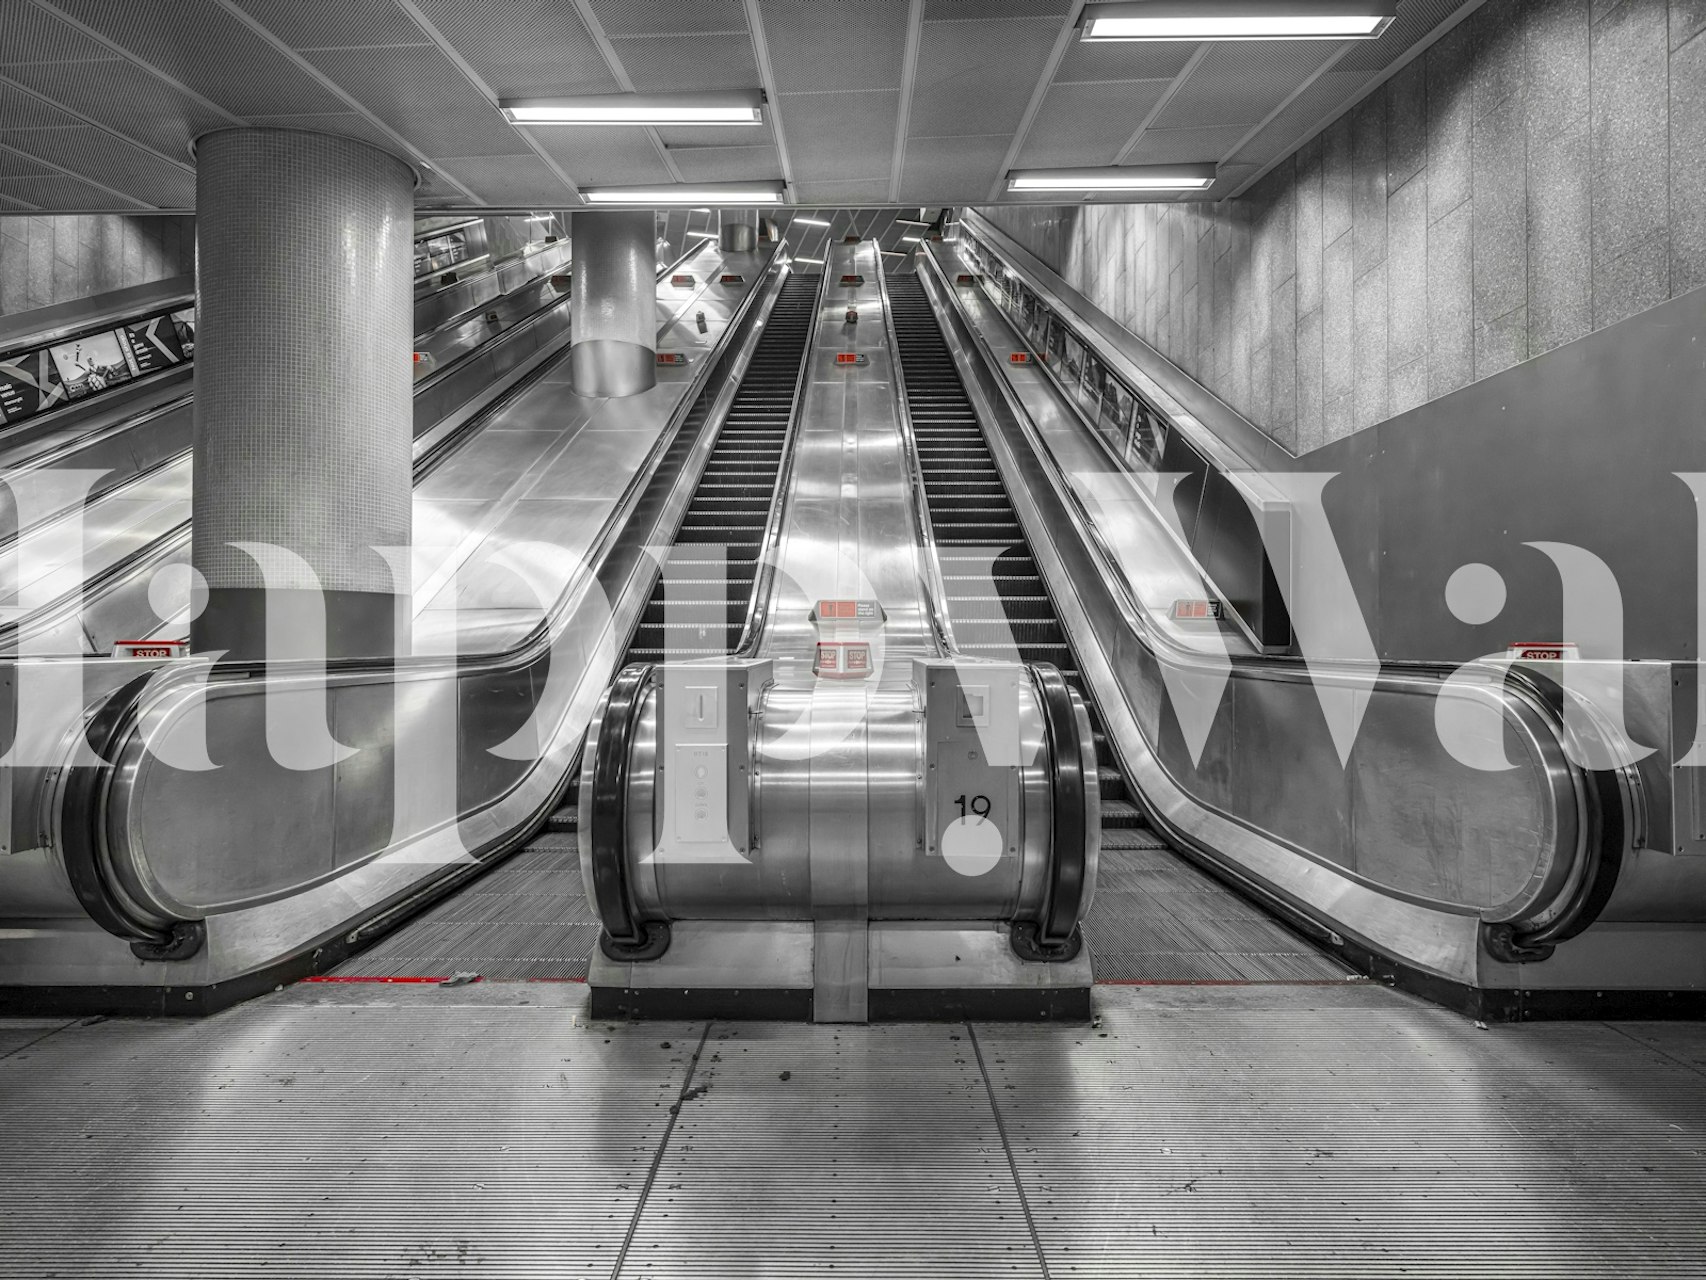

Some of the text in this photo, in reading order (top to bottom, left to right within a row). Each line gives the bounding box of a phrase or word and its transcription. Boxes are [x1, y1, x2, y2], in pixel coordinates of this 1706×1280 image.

[136, 649, 167, 657] STOP
[821, 650, 836, 660] STOP
[849, 650, 866, 660] STOP
[1526, 651, 1557, 659] STOP
[953, 794, 992, 826] 19
